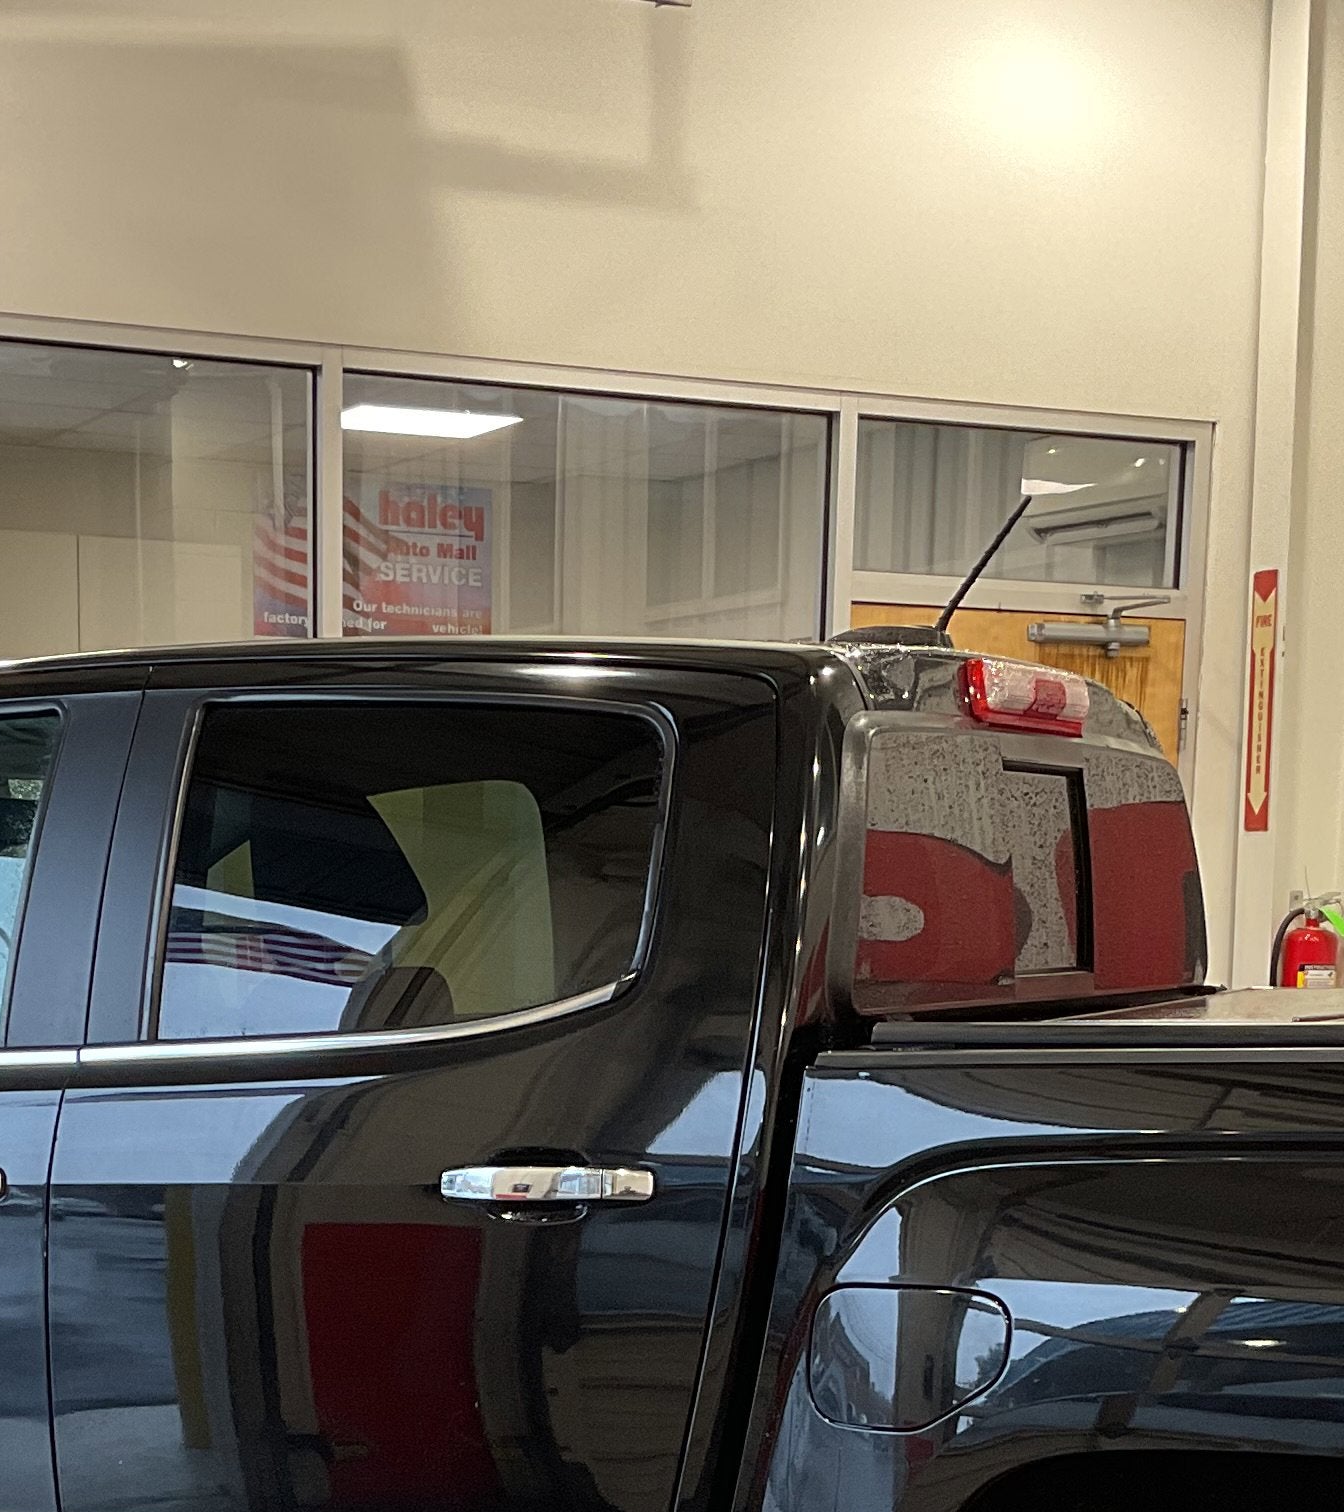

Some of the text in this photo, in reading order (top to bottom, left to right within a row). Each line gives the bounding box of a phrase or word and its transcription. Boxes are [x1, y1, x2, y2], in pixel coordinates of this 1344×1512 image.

[378, 490, 485, 542] haley
[387, 541, 477, 561] Auto Mall
[378, 561, 483, 587] SERVICE
[352, 600, 376, 613] Our
[381, 601, 456, 618] technicians
[367, 617, 388, 630] for
[1255, 614, 1273, 629] FIRE
[1255, 647, 1265, 775] EXTINGUISHER
